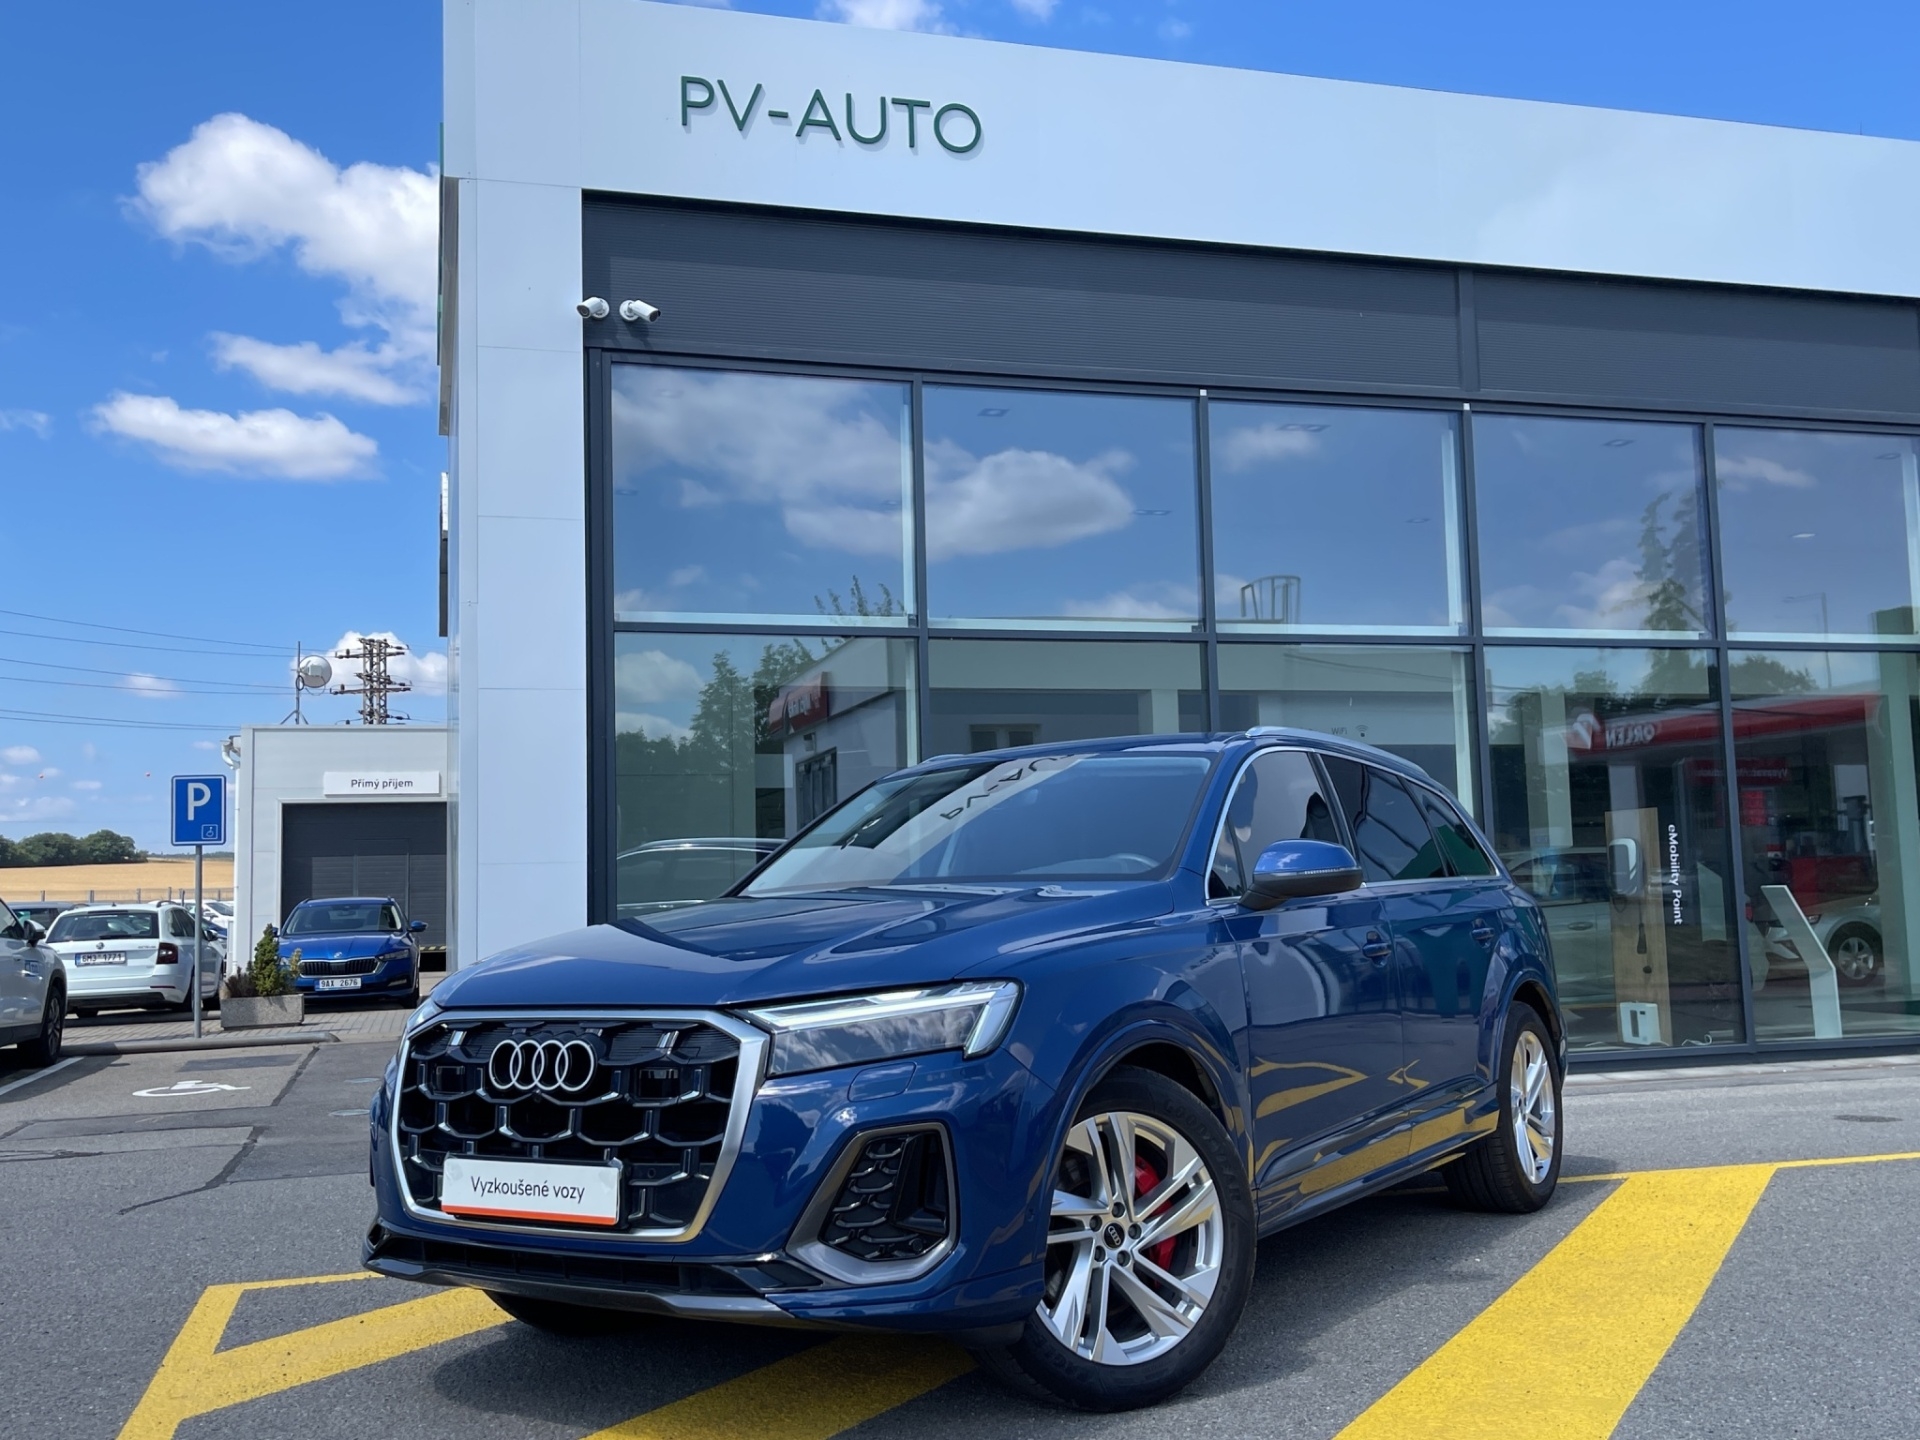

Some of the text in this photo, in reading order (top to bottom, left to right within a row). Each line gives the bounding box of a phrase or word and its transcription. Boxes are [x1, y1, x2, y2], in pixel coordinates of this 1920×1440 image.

[681, 75, 982, 154] PV-AUTO
[350, 778, 414, 790] Přímý příjem
[187, 782, 211, 821] P
[1668, 824, 1683, 925] eMobility Point
[339, 979, 358, 987] 2676
[471, 1175, 586, 1204] Vyzkoušené vozy
